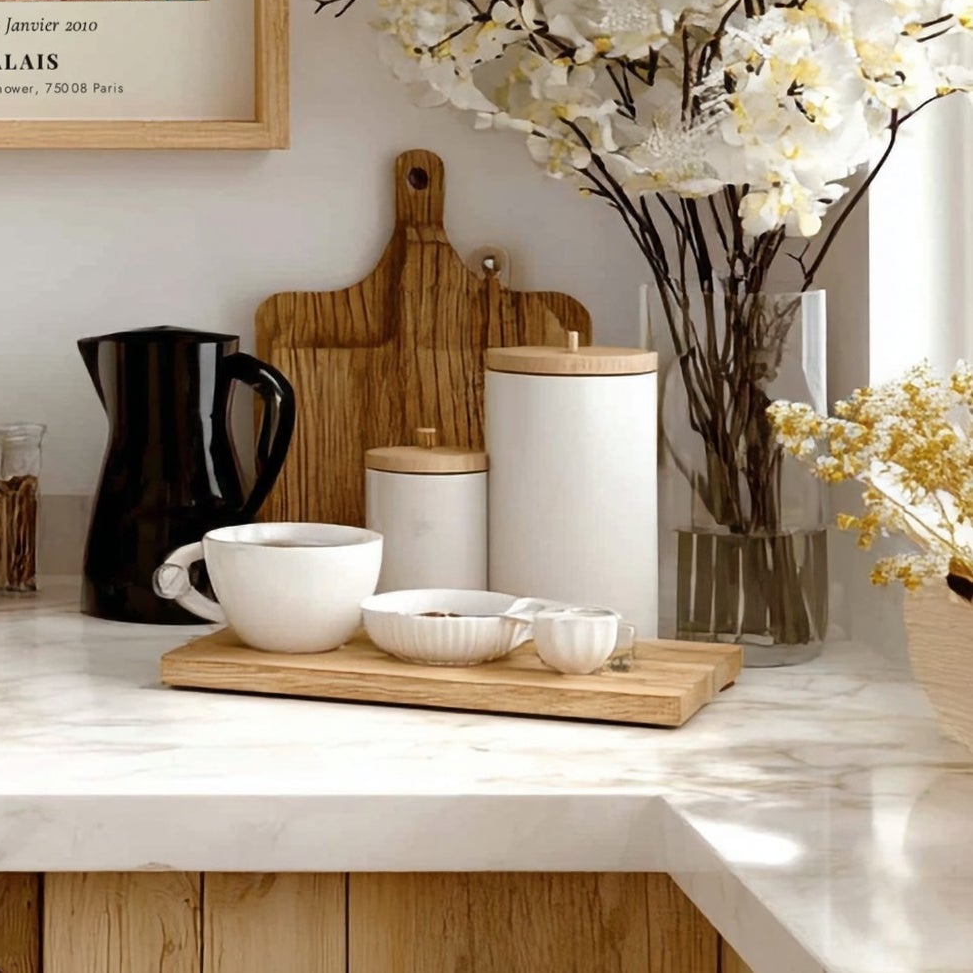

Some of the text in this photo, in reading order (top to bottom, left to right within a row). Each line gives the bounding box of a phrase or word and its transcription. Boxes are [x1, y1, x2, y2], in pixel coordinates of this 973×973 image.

[4, 16, 60, 36] Janvier
[64, 21, 98, 33] 2010
[44, 82, 88, 94] 75008
[92, 82, 124, 94] Paris
